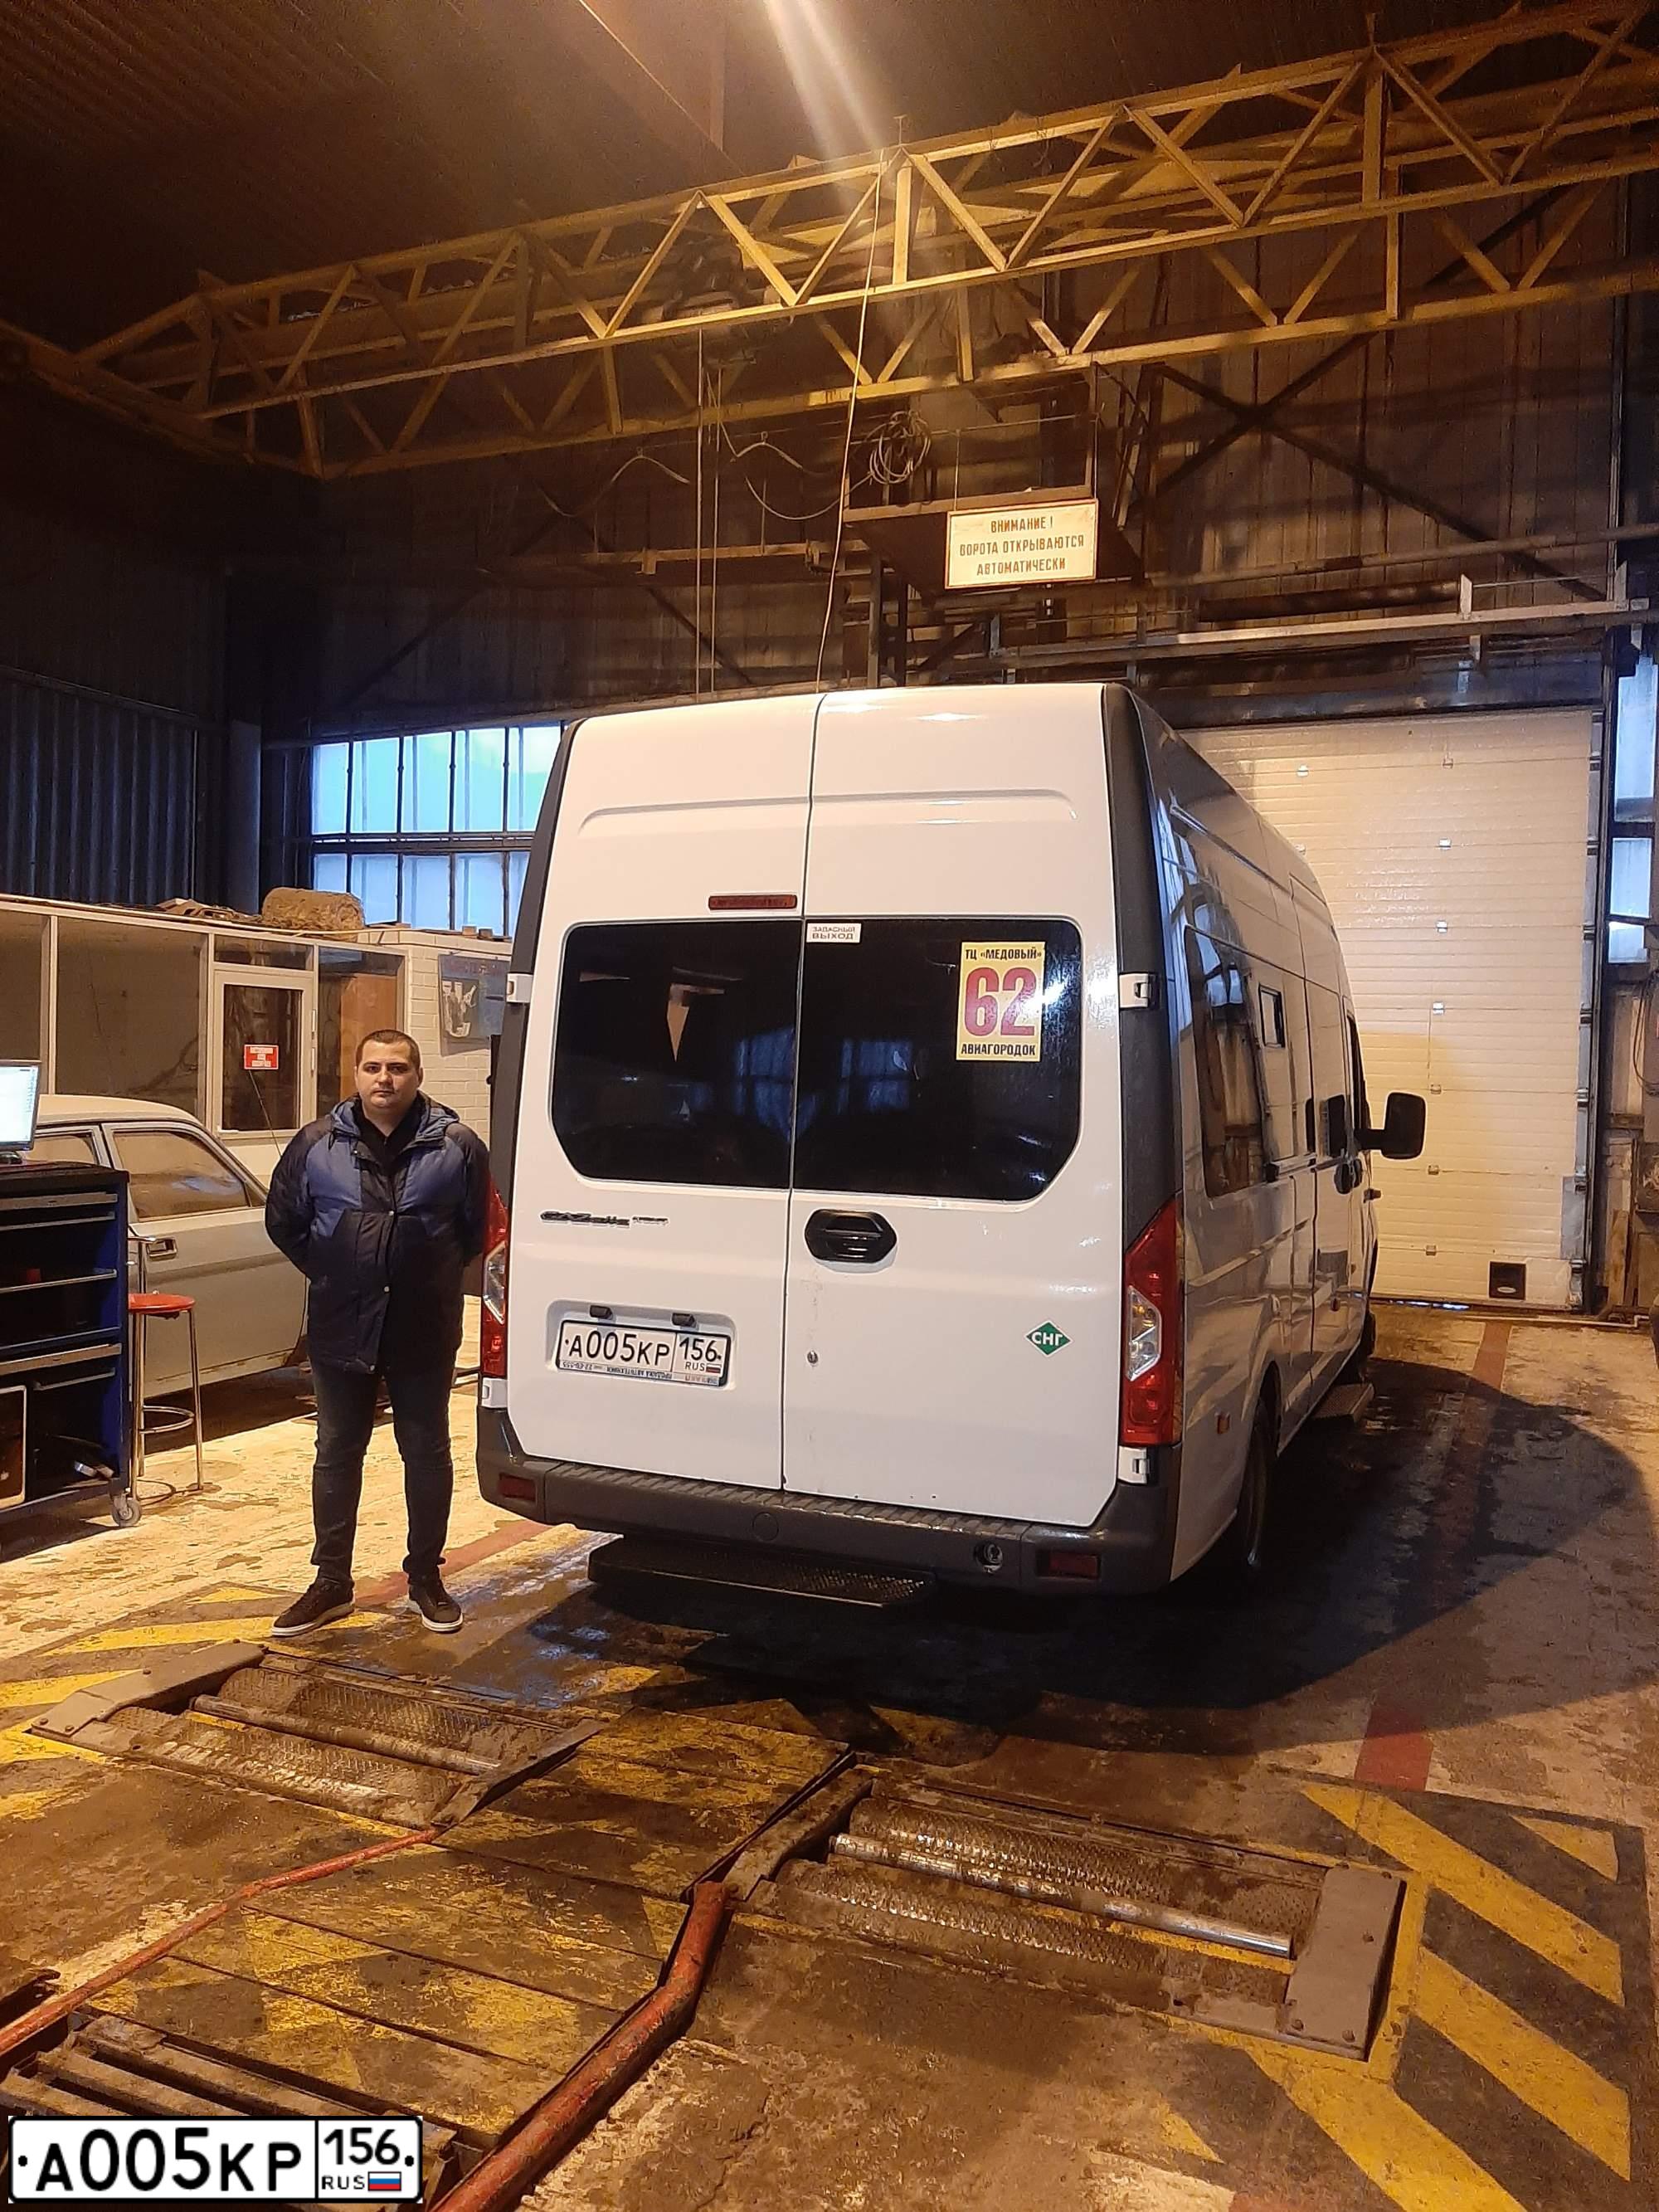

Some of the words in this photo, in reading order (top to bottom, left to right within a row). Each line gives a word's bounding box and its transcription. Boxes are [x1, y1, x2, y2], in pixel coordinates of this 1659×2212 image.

[960, 541, 999, 557] ВОРОТА
[1003, 534, 1084, 553] ОТКРЫВАЮТСЯ
[976, 557, 1066, 576] АВТОМАТИЧЕСКИ
[965, 948, 977, 960] ТЦ
[980, 946, 1042, 960] «МЕДОВЫЙ»
[964, 967, 1037, 1037] 62
[961, 1043, 1036, 1056] АВИАГОРОДОК
[568, 1330, 670, 1366] А005КР
[1031, 1331, 1063, 1346] СНГ
[679, 1337, 718, 1362] 156
[684, 1362, 706, 1372] RUS
